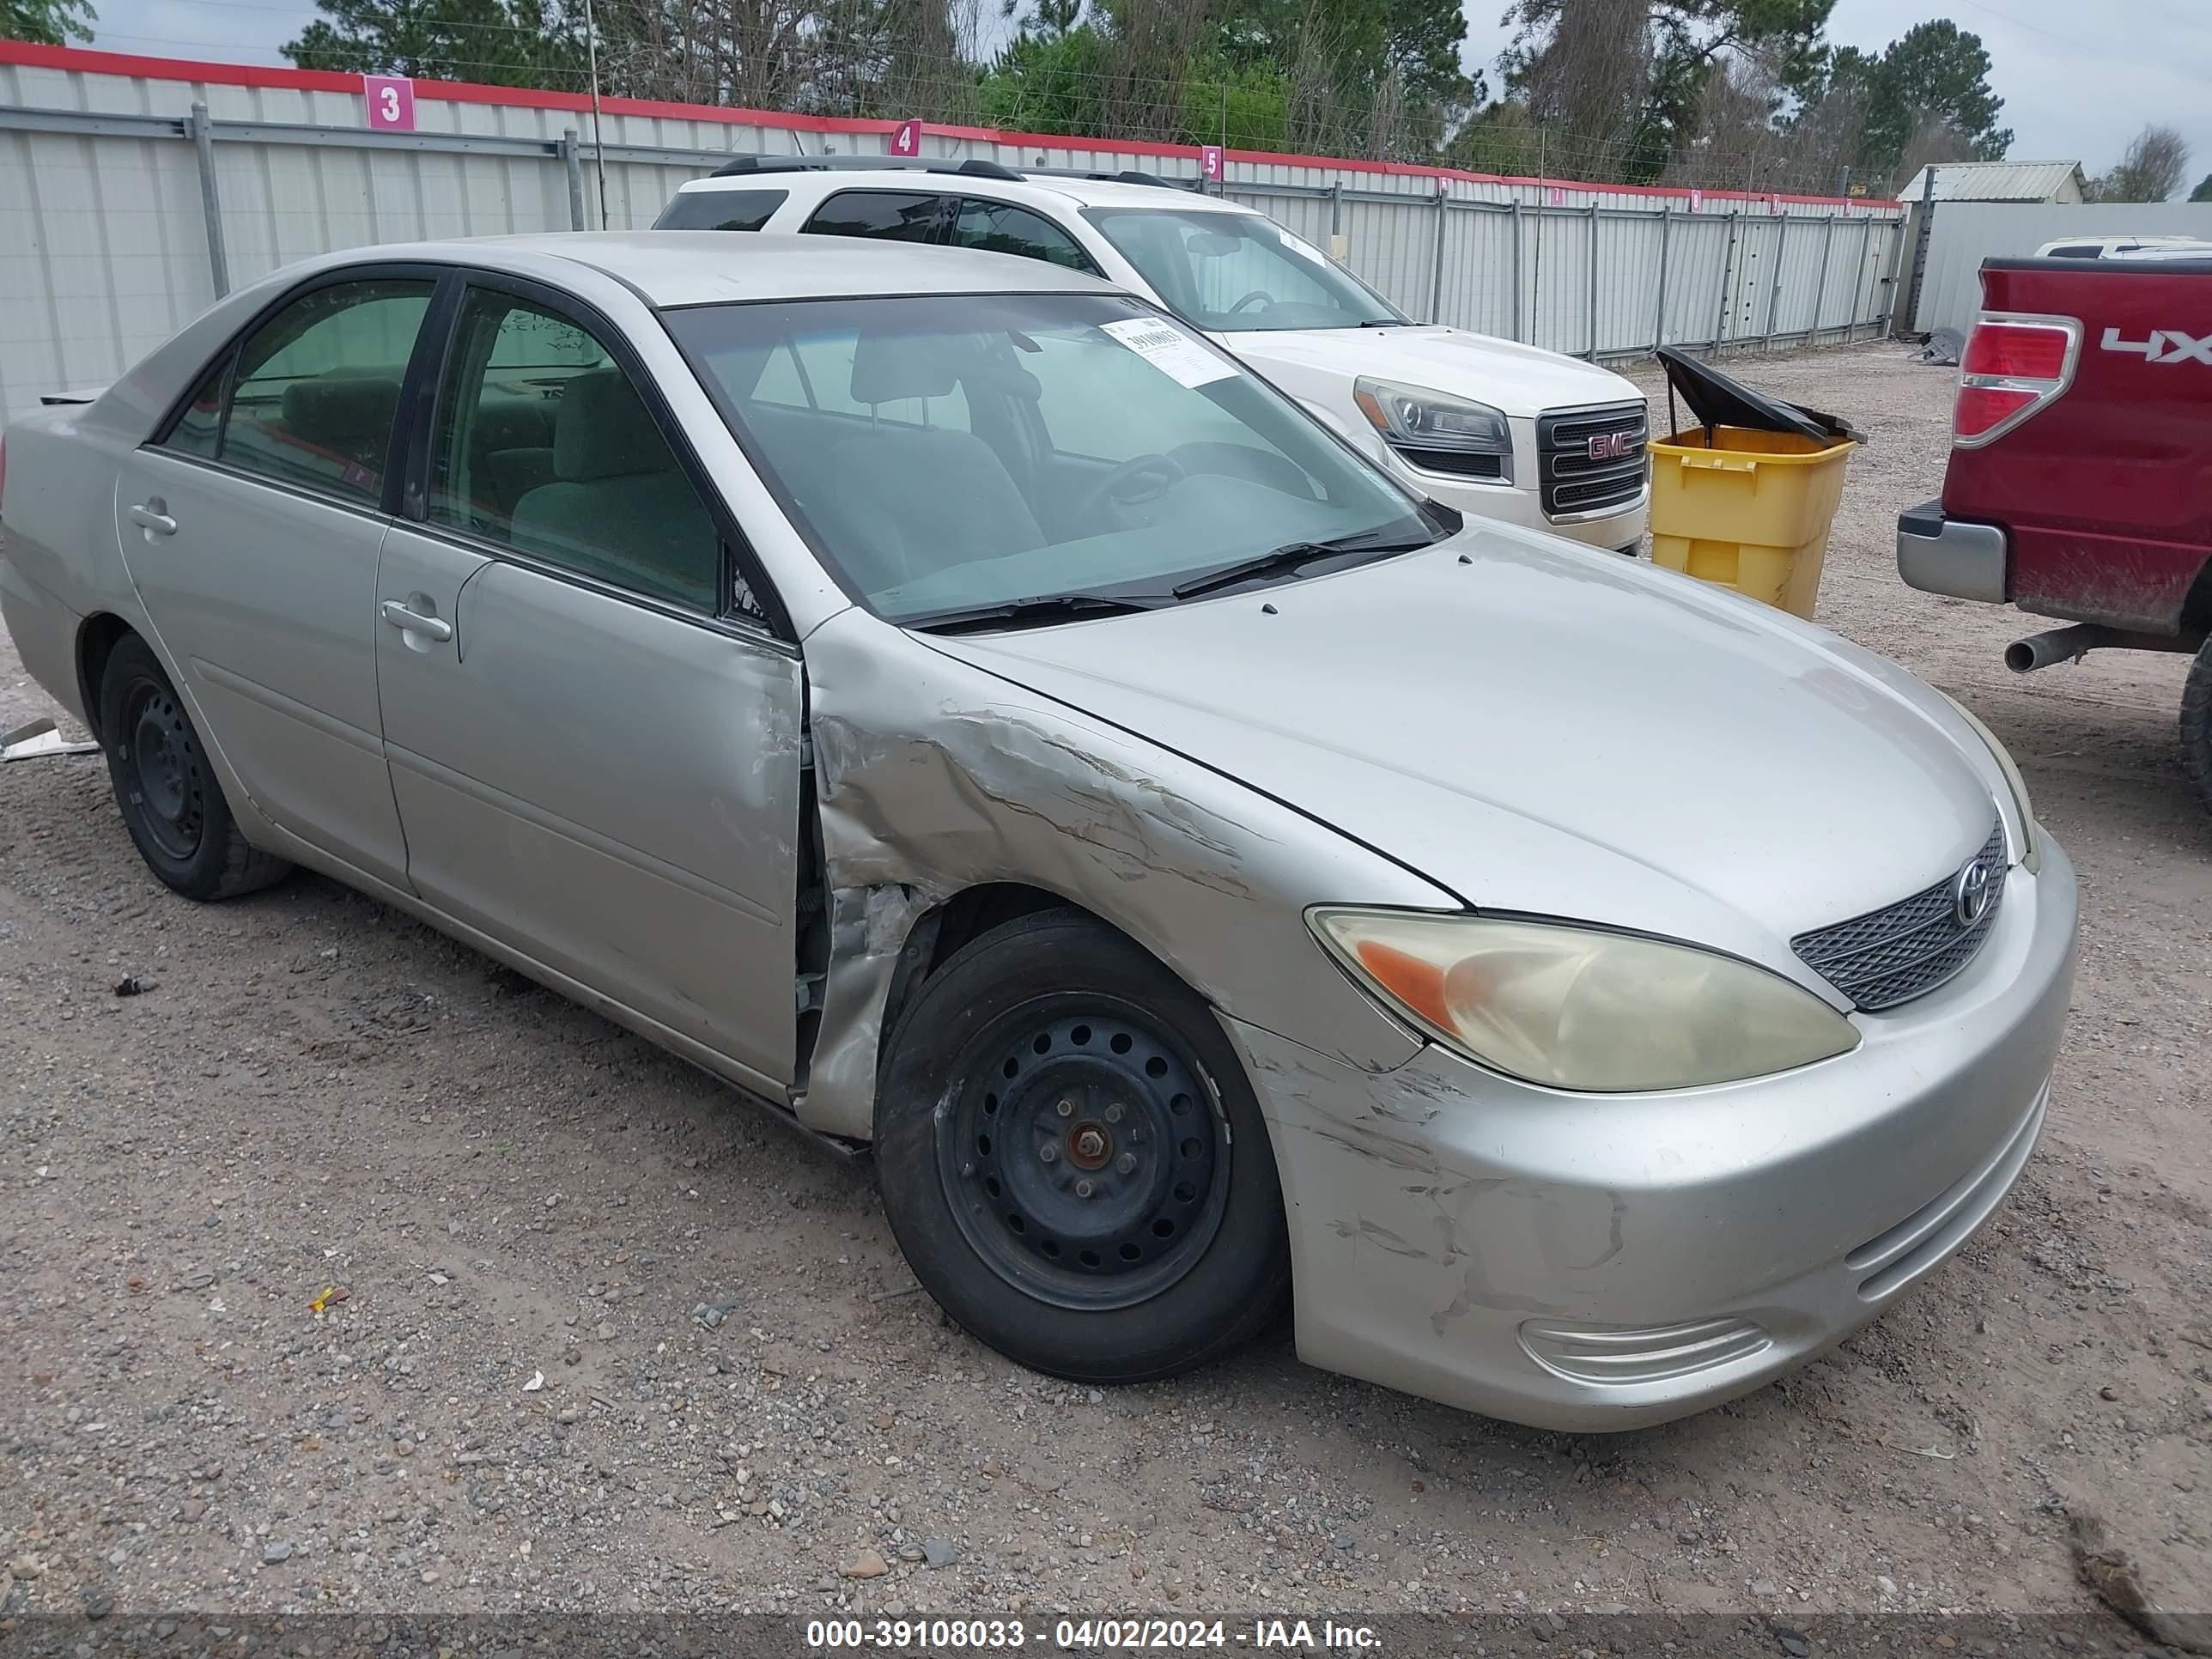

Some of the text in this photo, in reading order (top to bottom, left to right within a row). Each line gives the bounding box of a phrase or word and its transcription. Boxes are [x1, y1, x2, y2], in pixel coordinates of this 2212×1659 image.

[380, 87, 400, 122] 3
[898, 126, 911, 152] 4
[1207, 152, 1217, 174] 5
[1554, 187, 1560, 202] 7
[1693, 194, 1698, 208] 8
[1588, 431, 1633, 460] GMC
